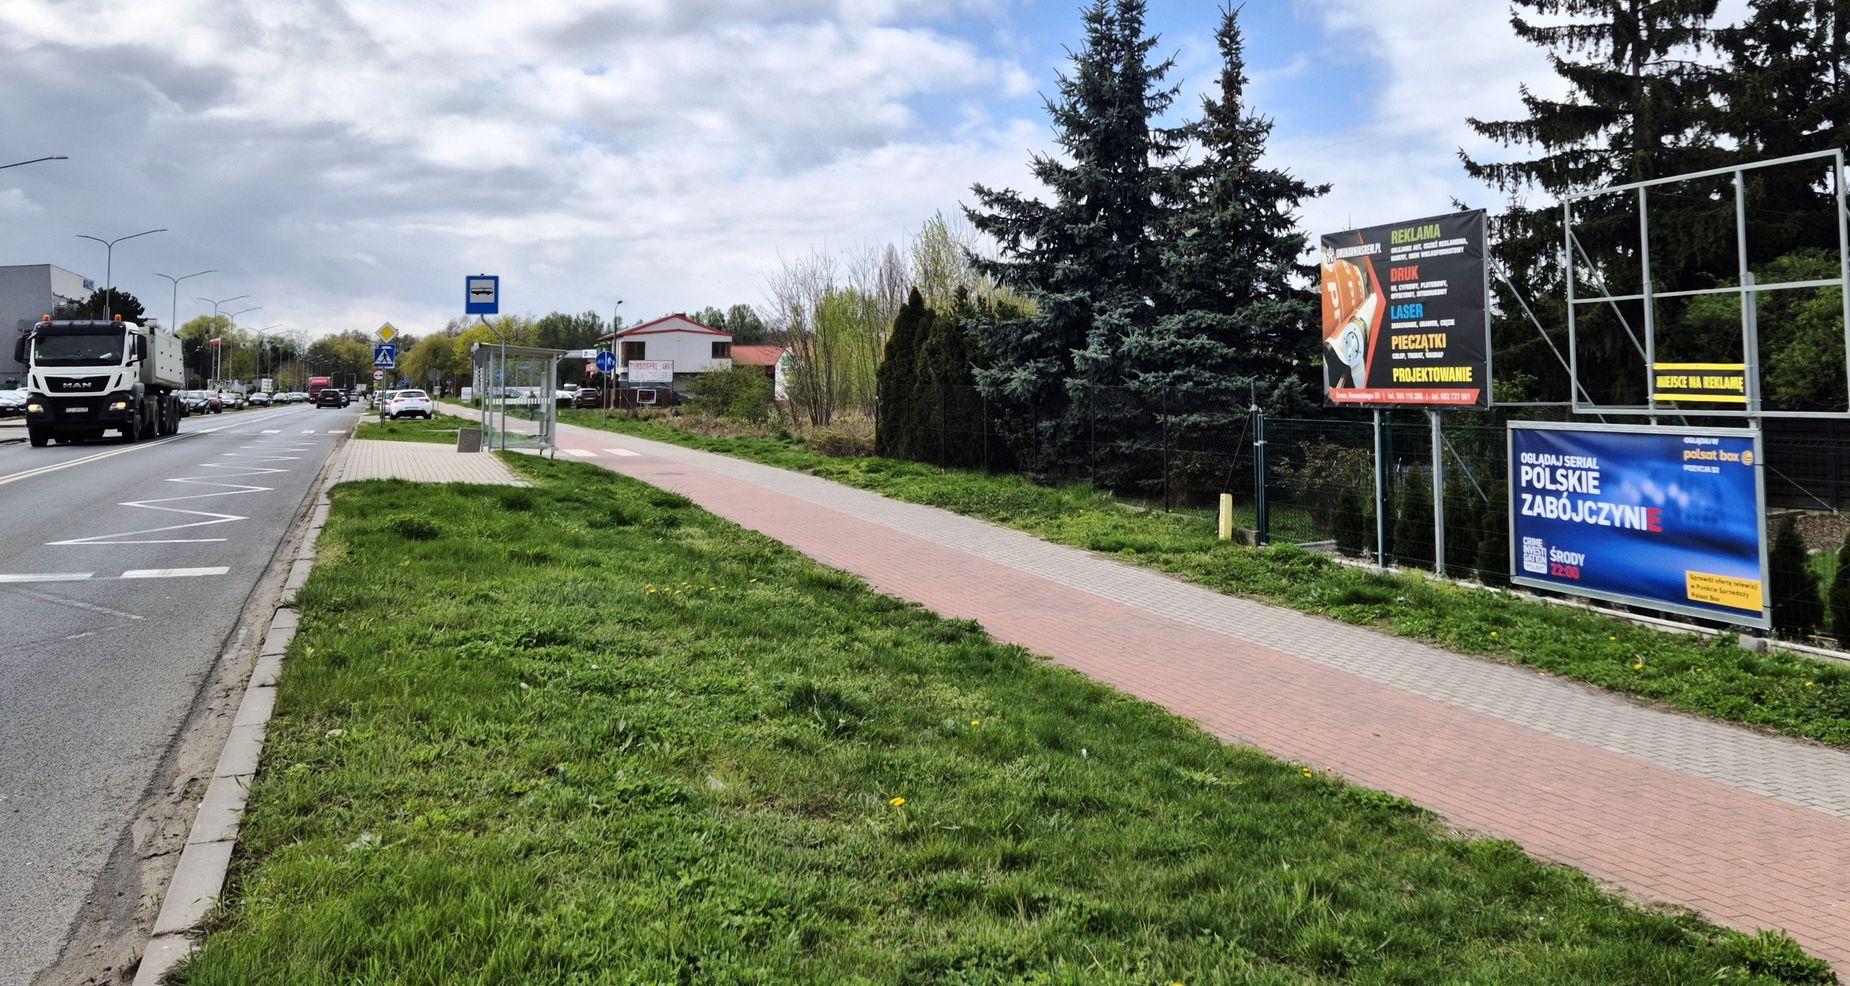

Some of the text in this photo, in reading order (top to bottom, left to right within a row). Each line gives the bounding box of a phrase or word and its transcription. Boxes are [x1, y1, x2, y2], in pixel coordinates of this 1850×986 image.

[1391, 224, 1440, 245] REKLAMA
[1391, 265, 1419, 283] DRUK
[1391, 304, 1423, 320] LASER
[1391, 333, 1446, 352] PIECZĄTKI
[1393, 367, 1473, 383] PROJEKTOWANIE
[1656, 376, 1744, 393] MIEJSCE NA REKLAMĘ
[1520, 452, 1600, 470] OGLĄDAJ SERIAL
[1683, 449, 1739, 462] polsat box
[1520, 465, 1600, 495] POLSKIE
[1521, 492, 1663, 533] ZABÓJCZYNIE
[1523, 537, 1543, 547] CRIME
[1550, 546, 1585, 567] ŚRODY
[1550, 562, 1580, 580] 22:00
